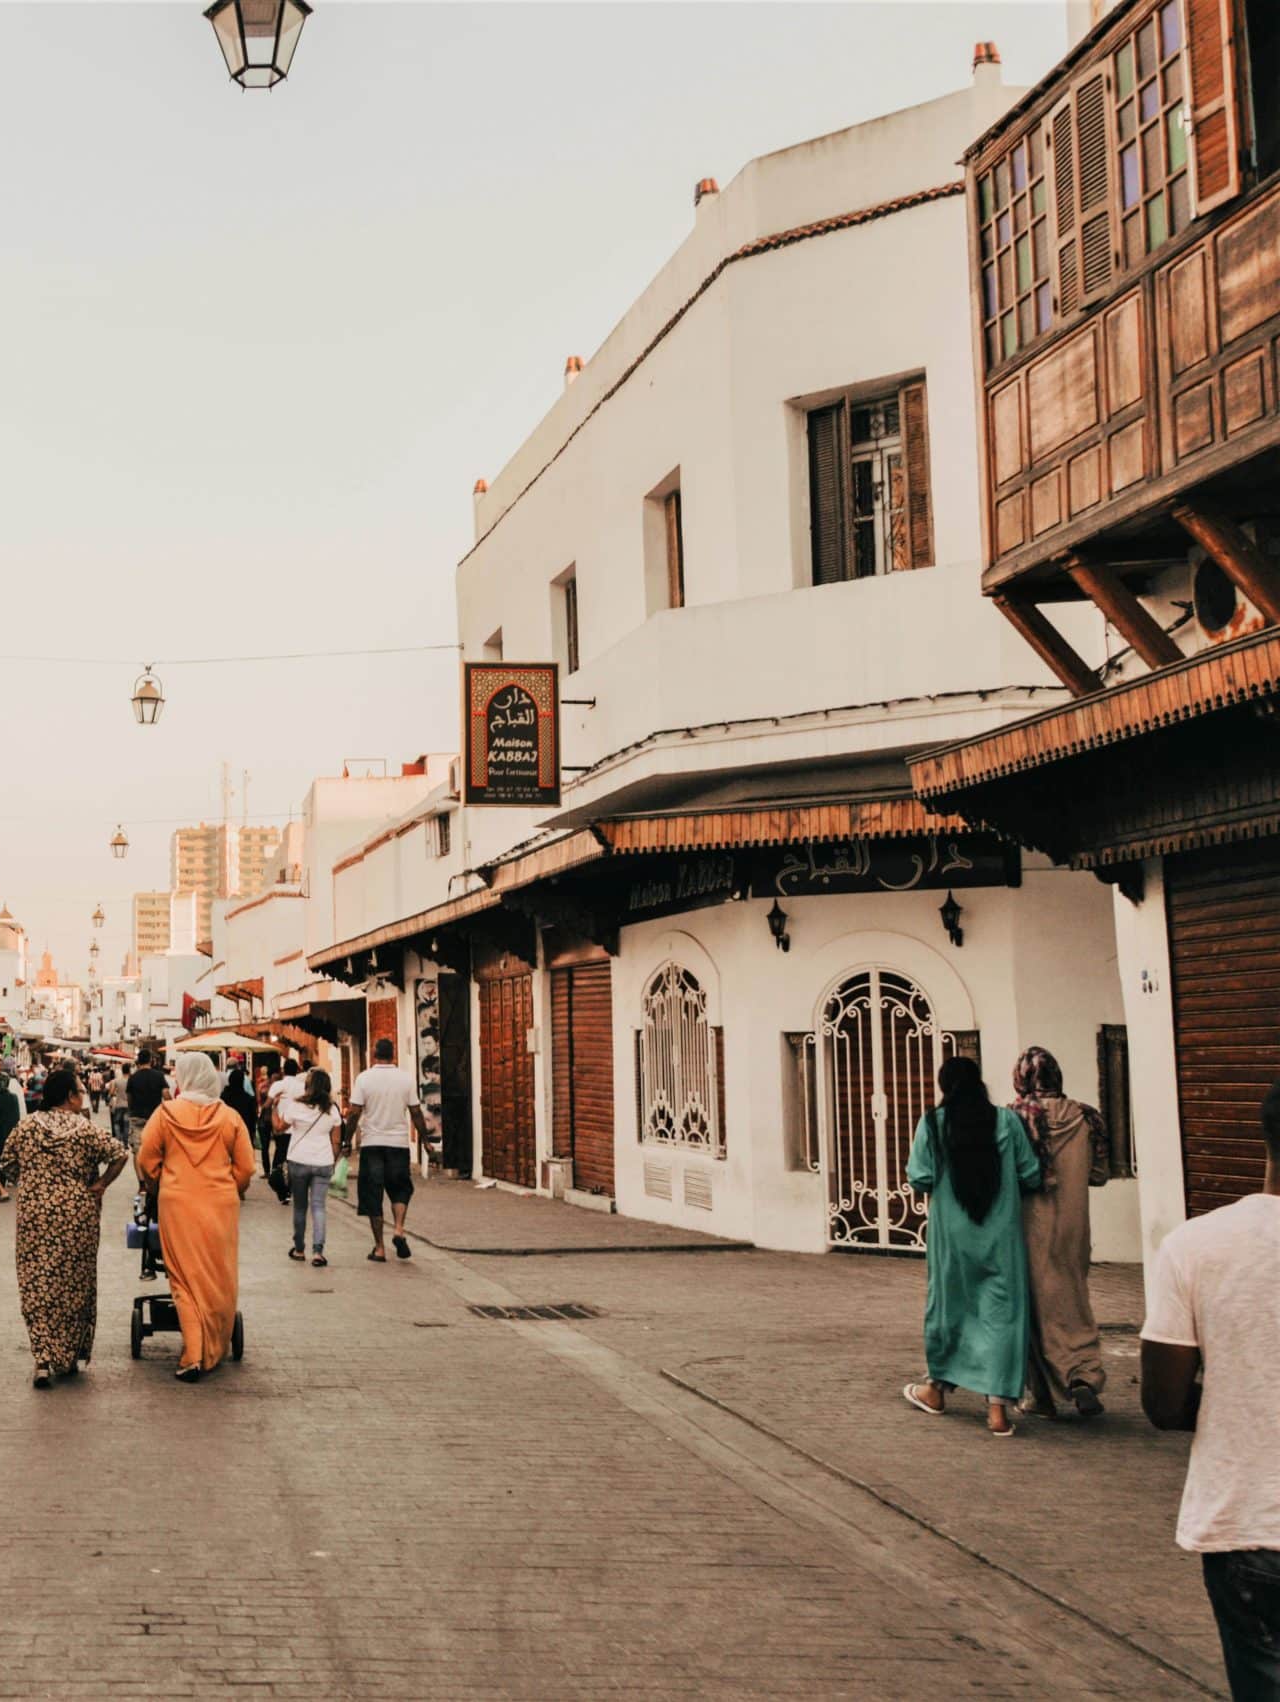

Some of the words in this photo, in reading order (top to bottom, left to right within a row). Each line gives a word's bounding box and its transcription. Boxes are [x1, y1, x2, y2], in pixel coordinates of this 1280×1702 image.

[493, 687, 531, 709] دار
[489, 709, 534, 734] القباج
[492, 737, 533, 748] Maison
[488, 751, 538, 763] KABBAJ
[877, 834, 974, 891] دار
